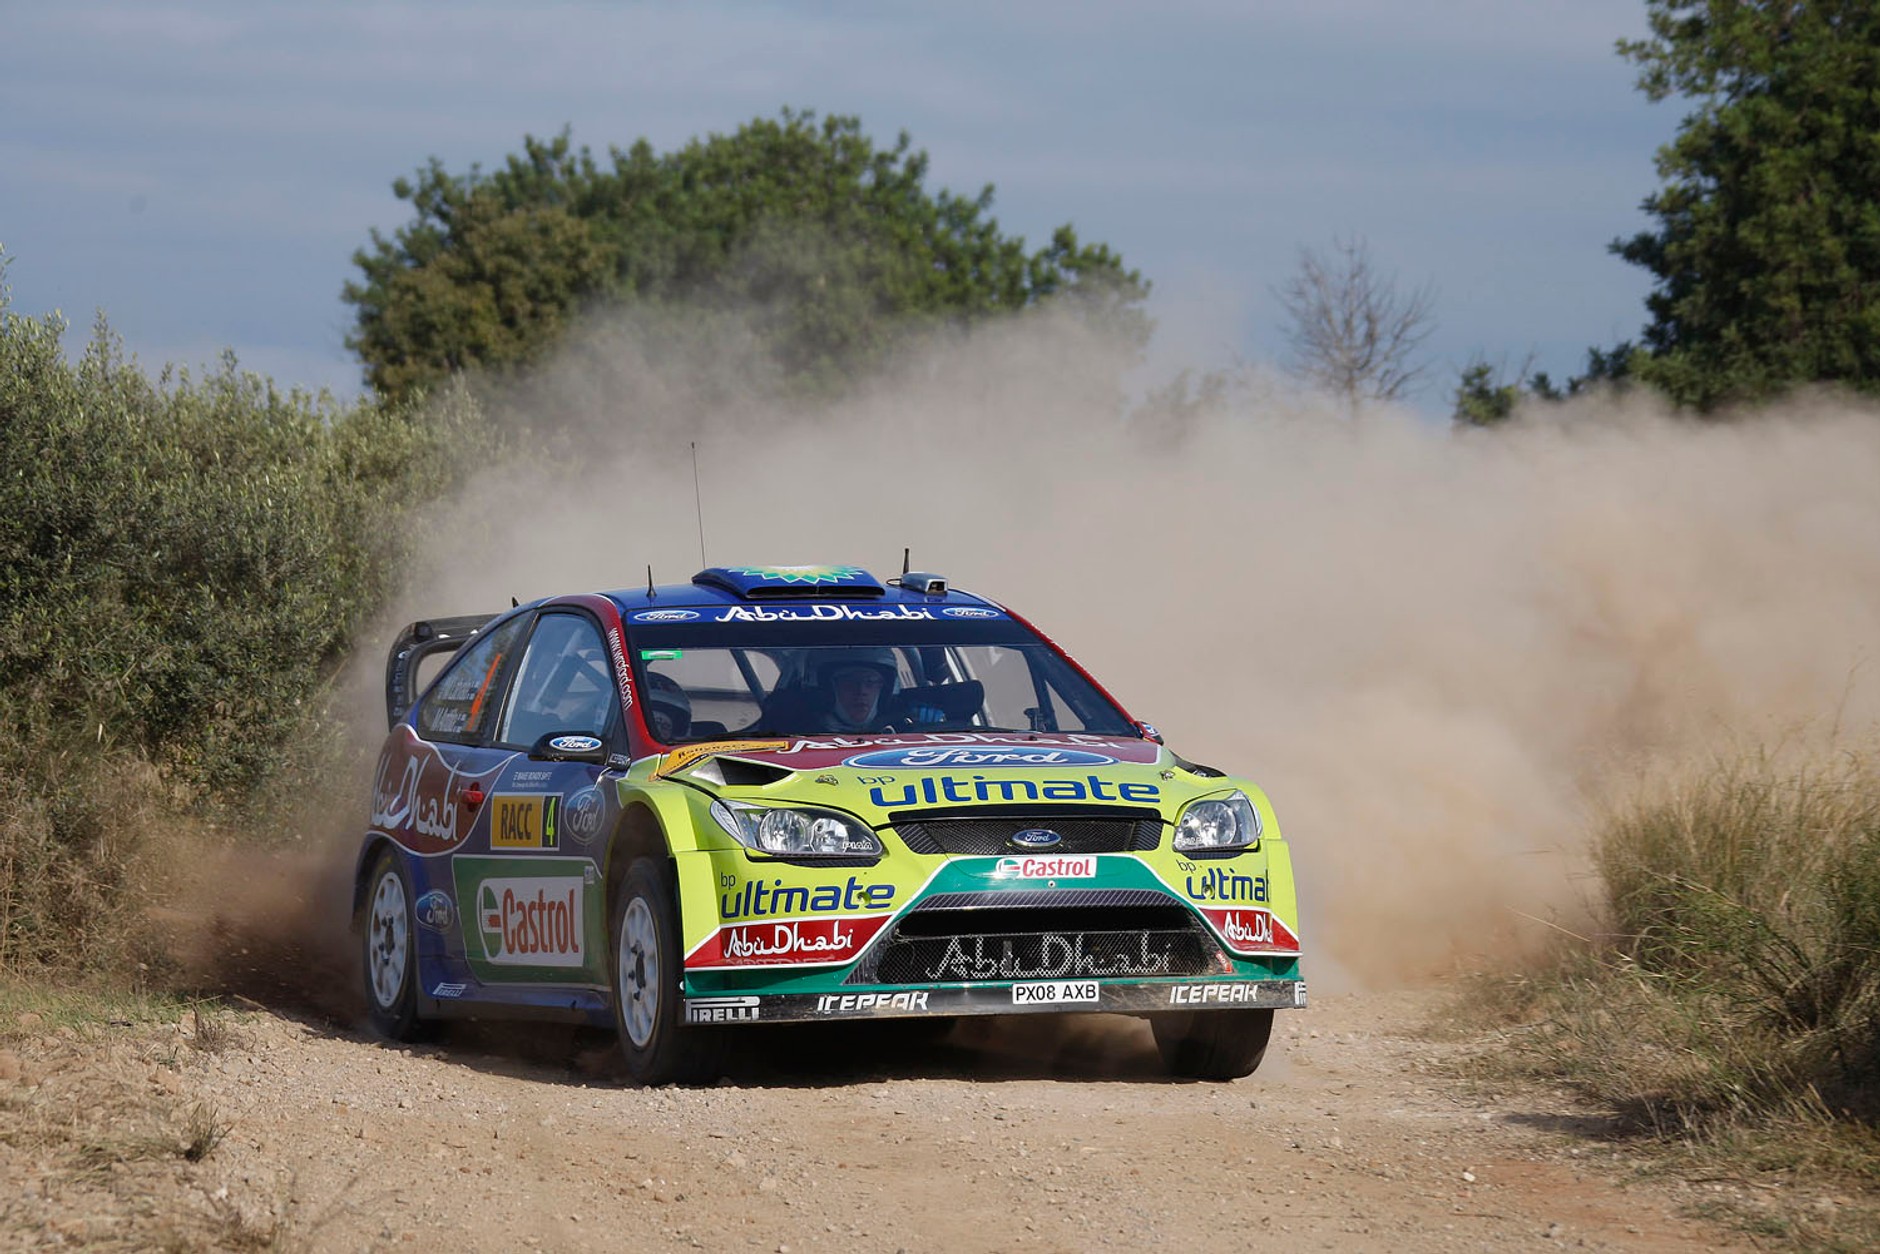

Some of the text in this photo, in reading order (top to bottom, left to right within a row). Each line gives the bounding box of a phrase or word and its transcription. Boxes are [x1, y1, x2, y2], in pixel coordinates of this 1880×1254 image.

[558, 736, 592, 748] Ford
[900, 748, 1069, 766] Ford
[856, 775, 896, 786] bp
[869, 775, 1161, 807] ultimate
[501, 803, 533, 840] RACC
[545, 796, 557, 847] 4
[1023, 831, 1051, 843] Ford
[1021, 858, 1092, 878] Castrol
[1176, 859, 1197, 874] bp
[720, 872, 736, 891] bp
[721, 876, 896, 919] ultimate
[502, 887, 580, 955] Castrol
[1017, 983, 1097, 1002] PX08 AXB
[1169, 983, 1259, 1005] ICEPEAK
[686, 995, 760, 1023] PIRELLI
